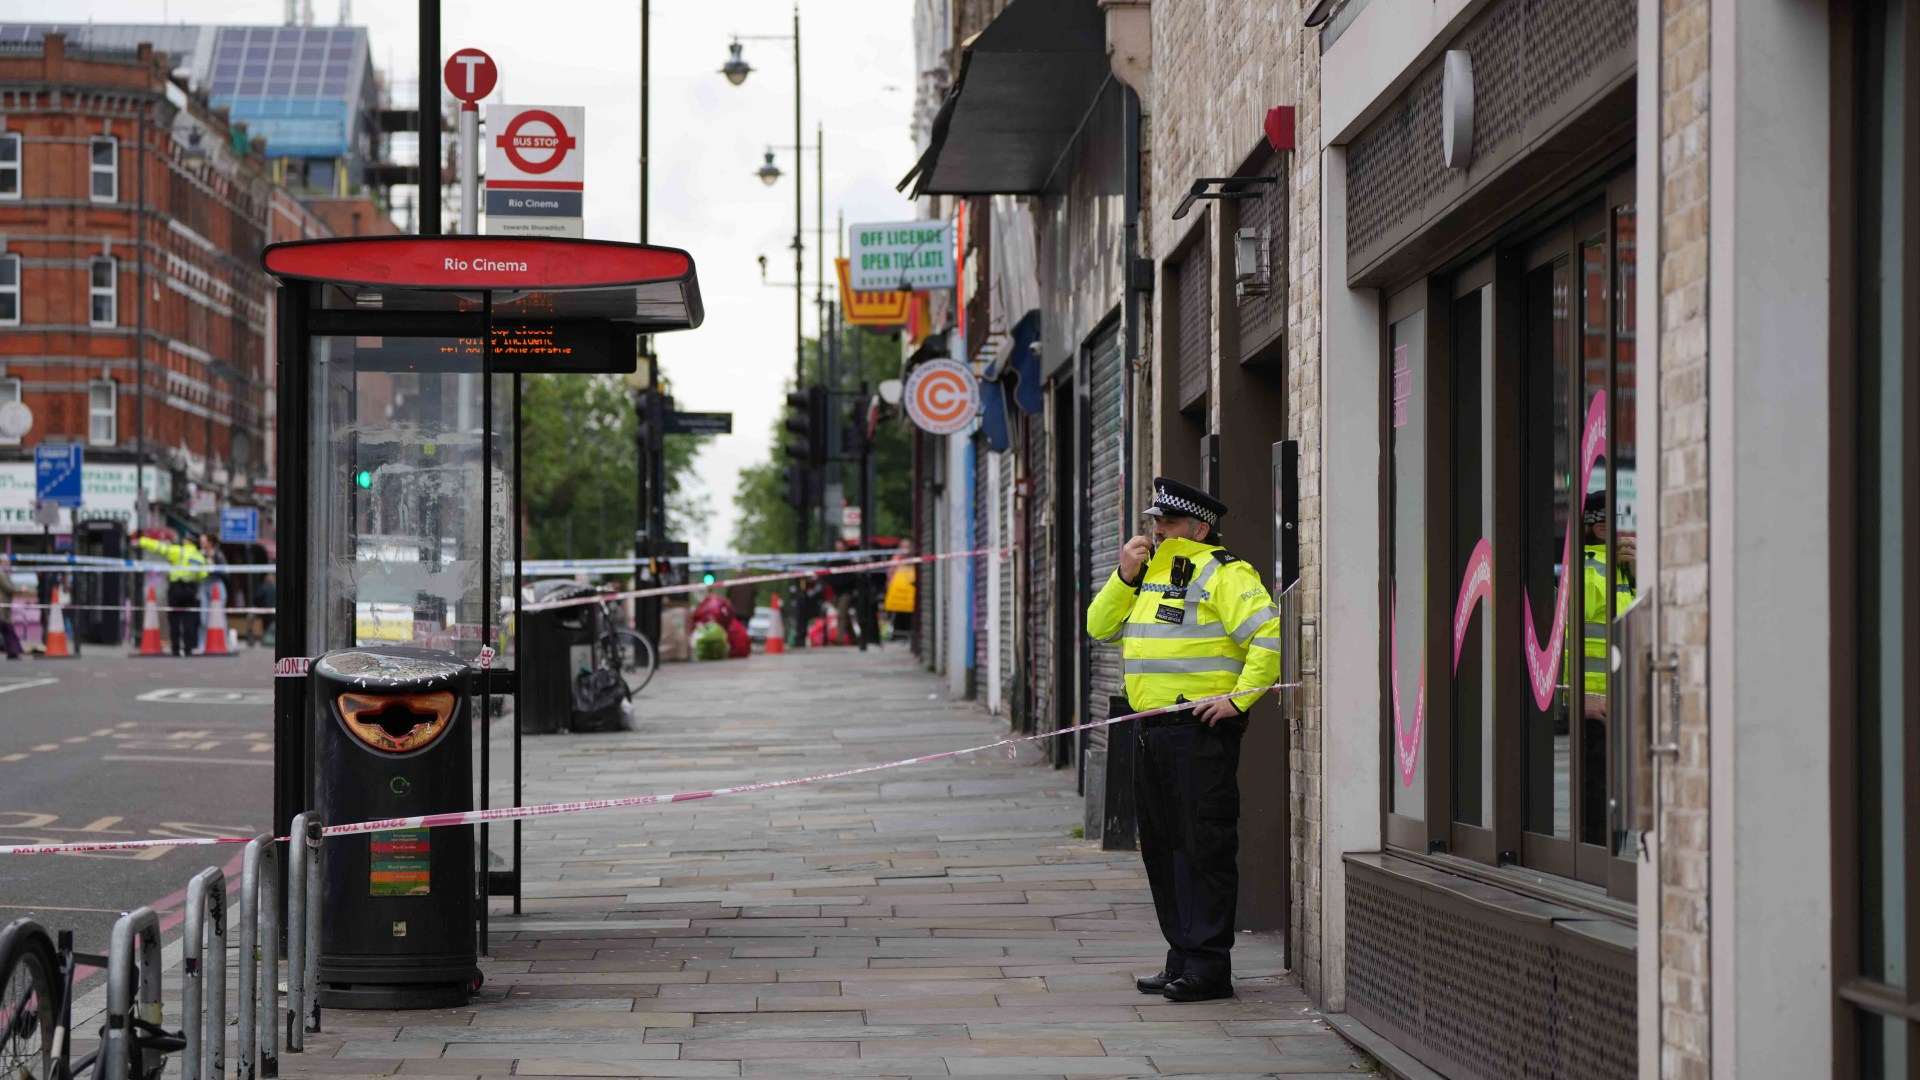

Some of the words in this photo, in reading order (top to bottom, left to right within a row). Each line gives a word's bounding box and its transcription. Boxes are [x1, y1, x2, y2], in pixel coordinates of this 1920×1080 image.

[456, 56, 485, 93] T
[513, 138, 531, 146] BUS
[534, 138, 559, 147] STOP
[508, 199, 523, 208] Rio
[525, 199, 559, 209] Cinema
[861, 231, 881, 246] OFF
[444, 257, 468, 271] Rio
[472, 258, 528, 272] Cinema
[862, 253, 890, 270] OPEN
[918, 251, 944, 268] LATE
